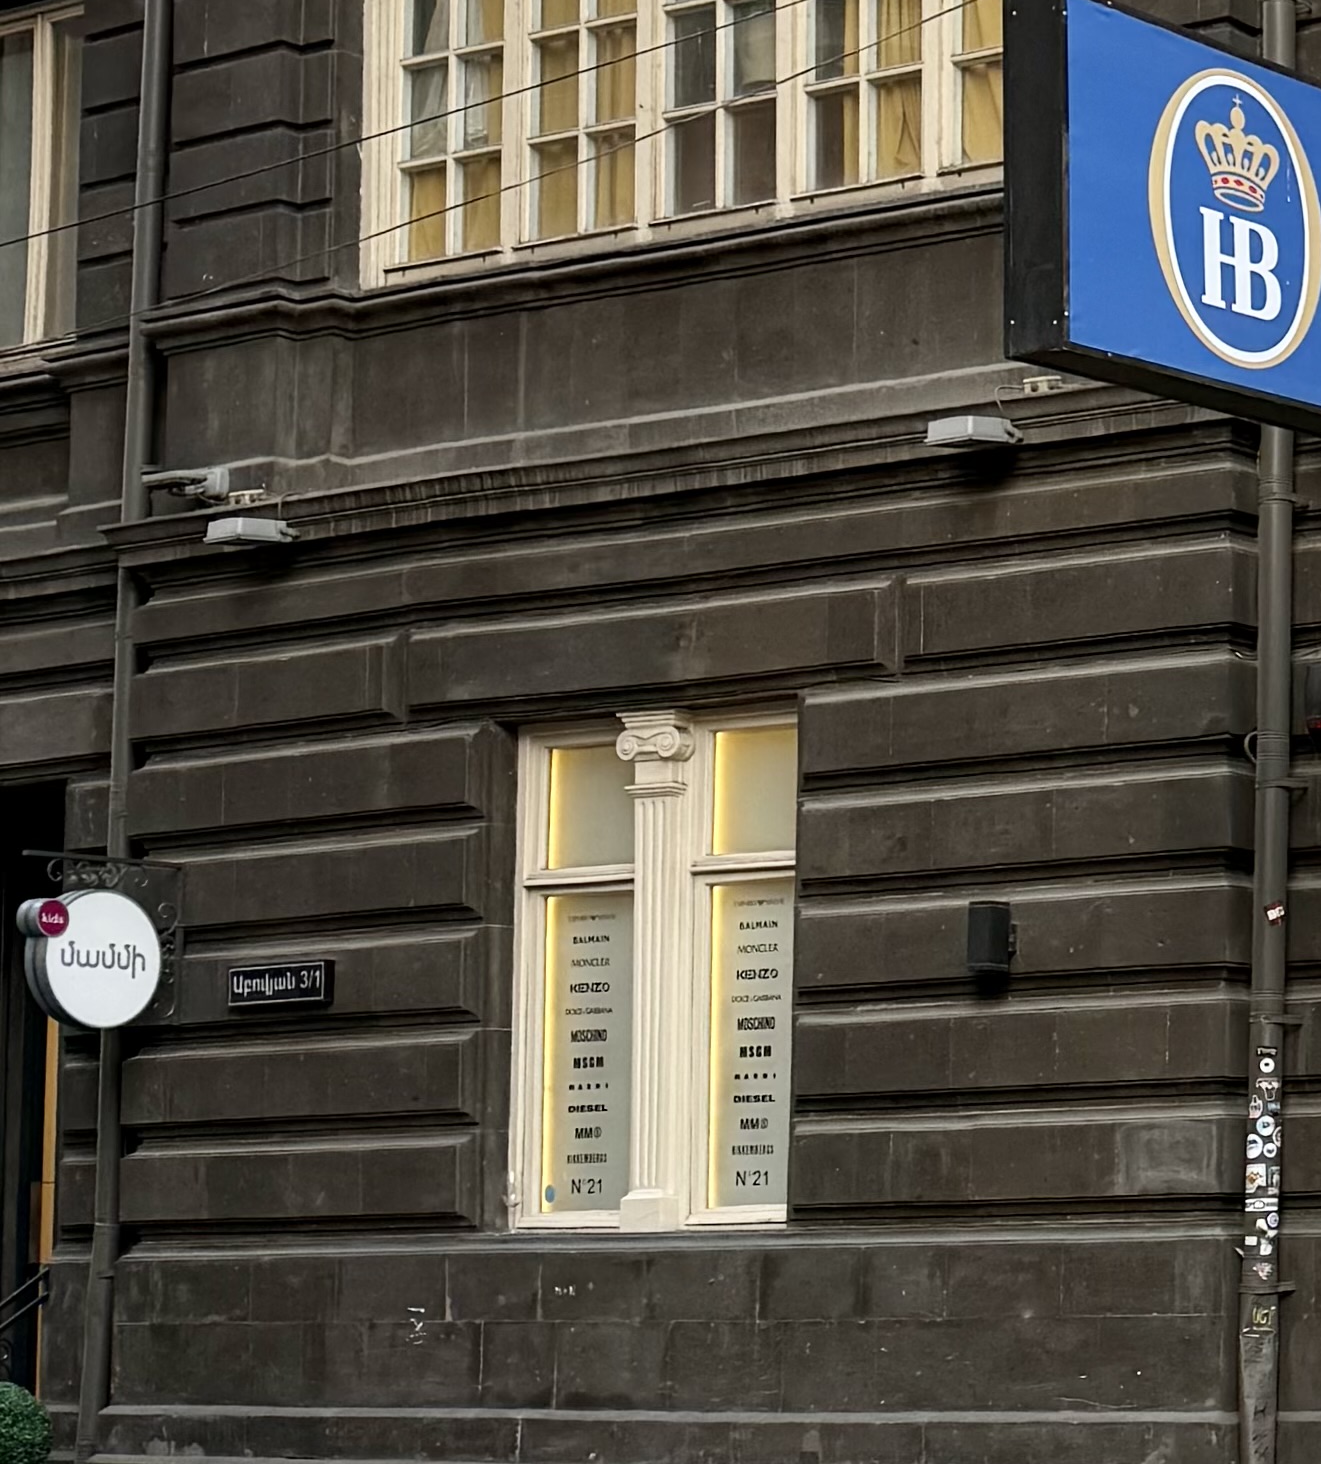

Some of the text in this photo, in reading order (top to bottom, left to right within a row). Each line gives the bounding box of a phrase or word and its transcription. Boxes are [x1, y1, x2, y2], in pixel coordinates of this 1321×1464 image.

[1200, 205, 1282, 321] HB
[42, 912, 64, 924] kids
[740, 920, 778, 930] BALMAIN
[573, 935, 610, 944] BALMAIN
[737, 943, 779, 954] MONCLER
[61, 941, 145, 979] մամմի
[571, 958, 610, 967] MONCLER
[737, 968, 778, 980] KENZO
[233, 970, 320, 998] Աբովյան 3/1
[570, 982, 610, 993] KENZO
[737, 1017, 775, 1030] MOSCHINO
[571, 1029, 607, 1042] MOSCHINO
[740, 1046, 771, 1057] MSGM
[573, 1056, 604, 1068] MSGM
[733, 1094, 775, 1103] DIESEL
[568, 1104, 608, 1113] DIESEL
